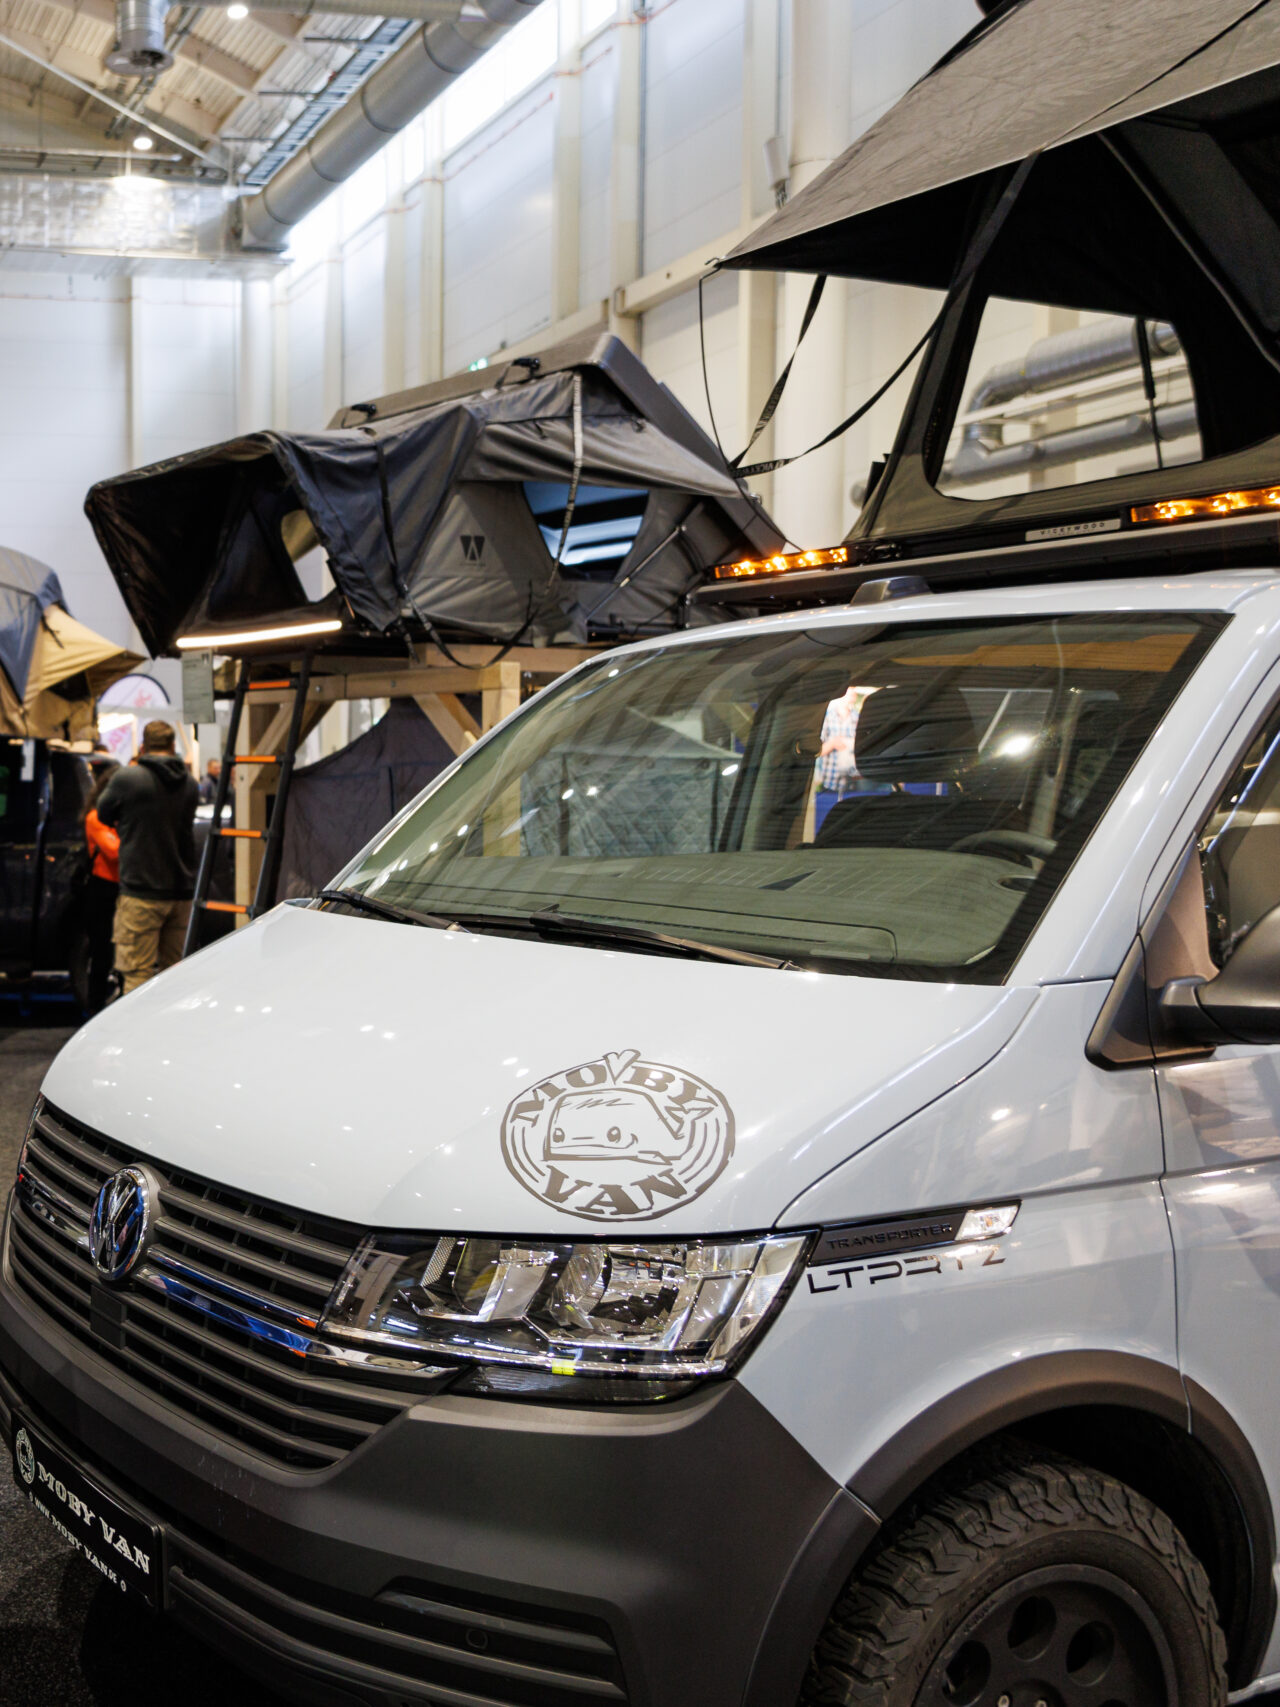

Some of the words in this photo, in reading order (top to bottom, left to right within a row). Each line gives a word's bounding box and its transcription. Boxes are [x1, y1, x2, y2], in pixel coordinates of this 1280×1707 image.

[510, 1063, 719, 1128] MOBY
[542, 1164, 688, 1215] VAN
[826, 1222, 953, 1250] TRANSPORTER
[37, 1461, 95, 1526] MOBY
[99, 1516, 150, 1575] VAN
